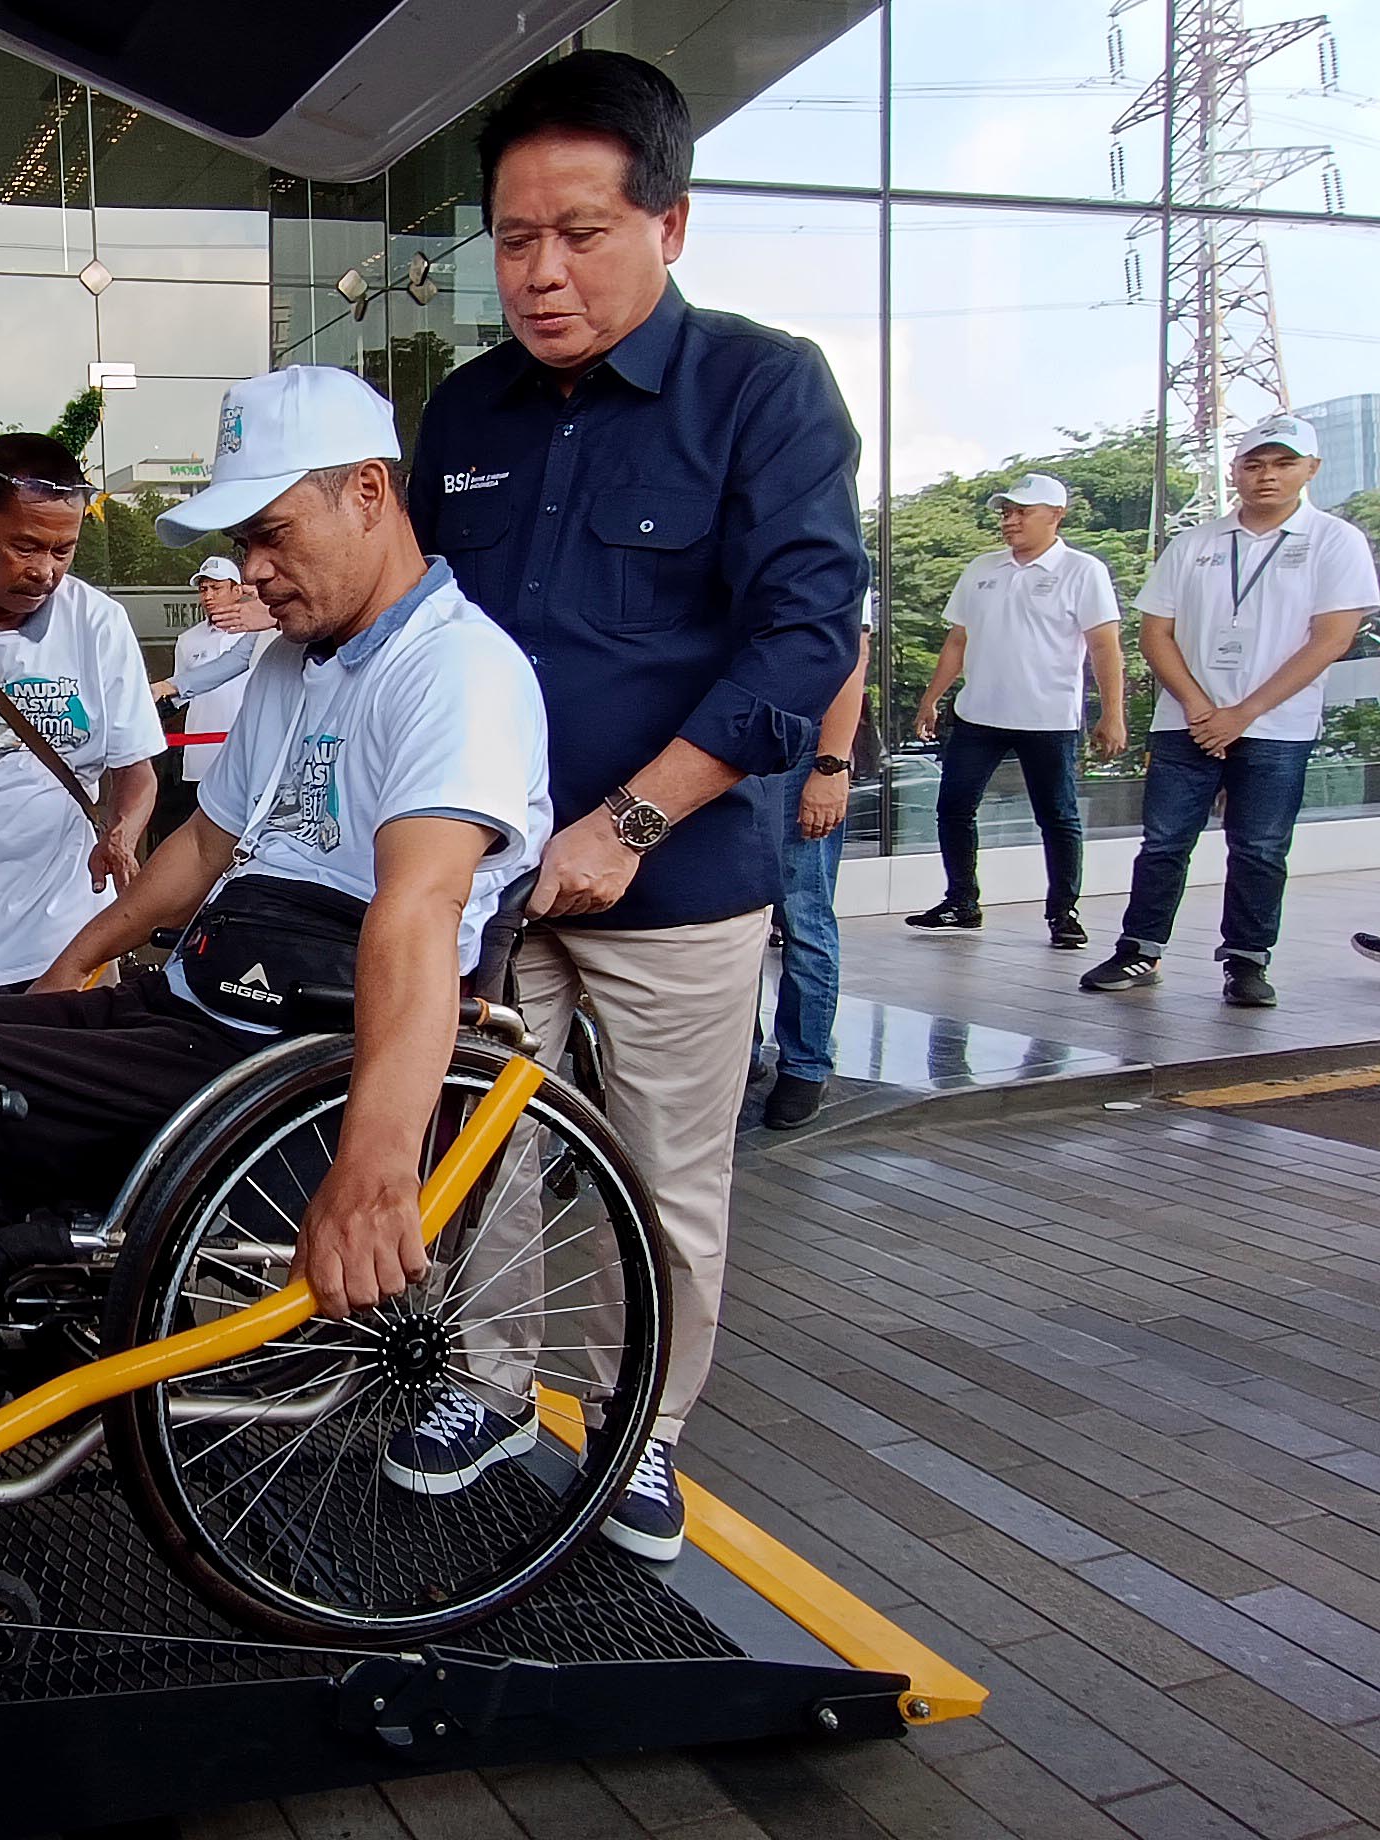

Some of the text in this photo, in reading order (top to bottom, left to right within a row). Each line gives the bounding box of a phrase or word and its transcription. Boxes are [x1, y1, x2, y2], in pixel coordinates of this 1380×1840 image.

[443, 472, 471, 494] BSI
[163, 602, 189, 628] THE
[16, 697, 71, 712] ASYIK
[219, 981, 283, 1005] EIGER
